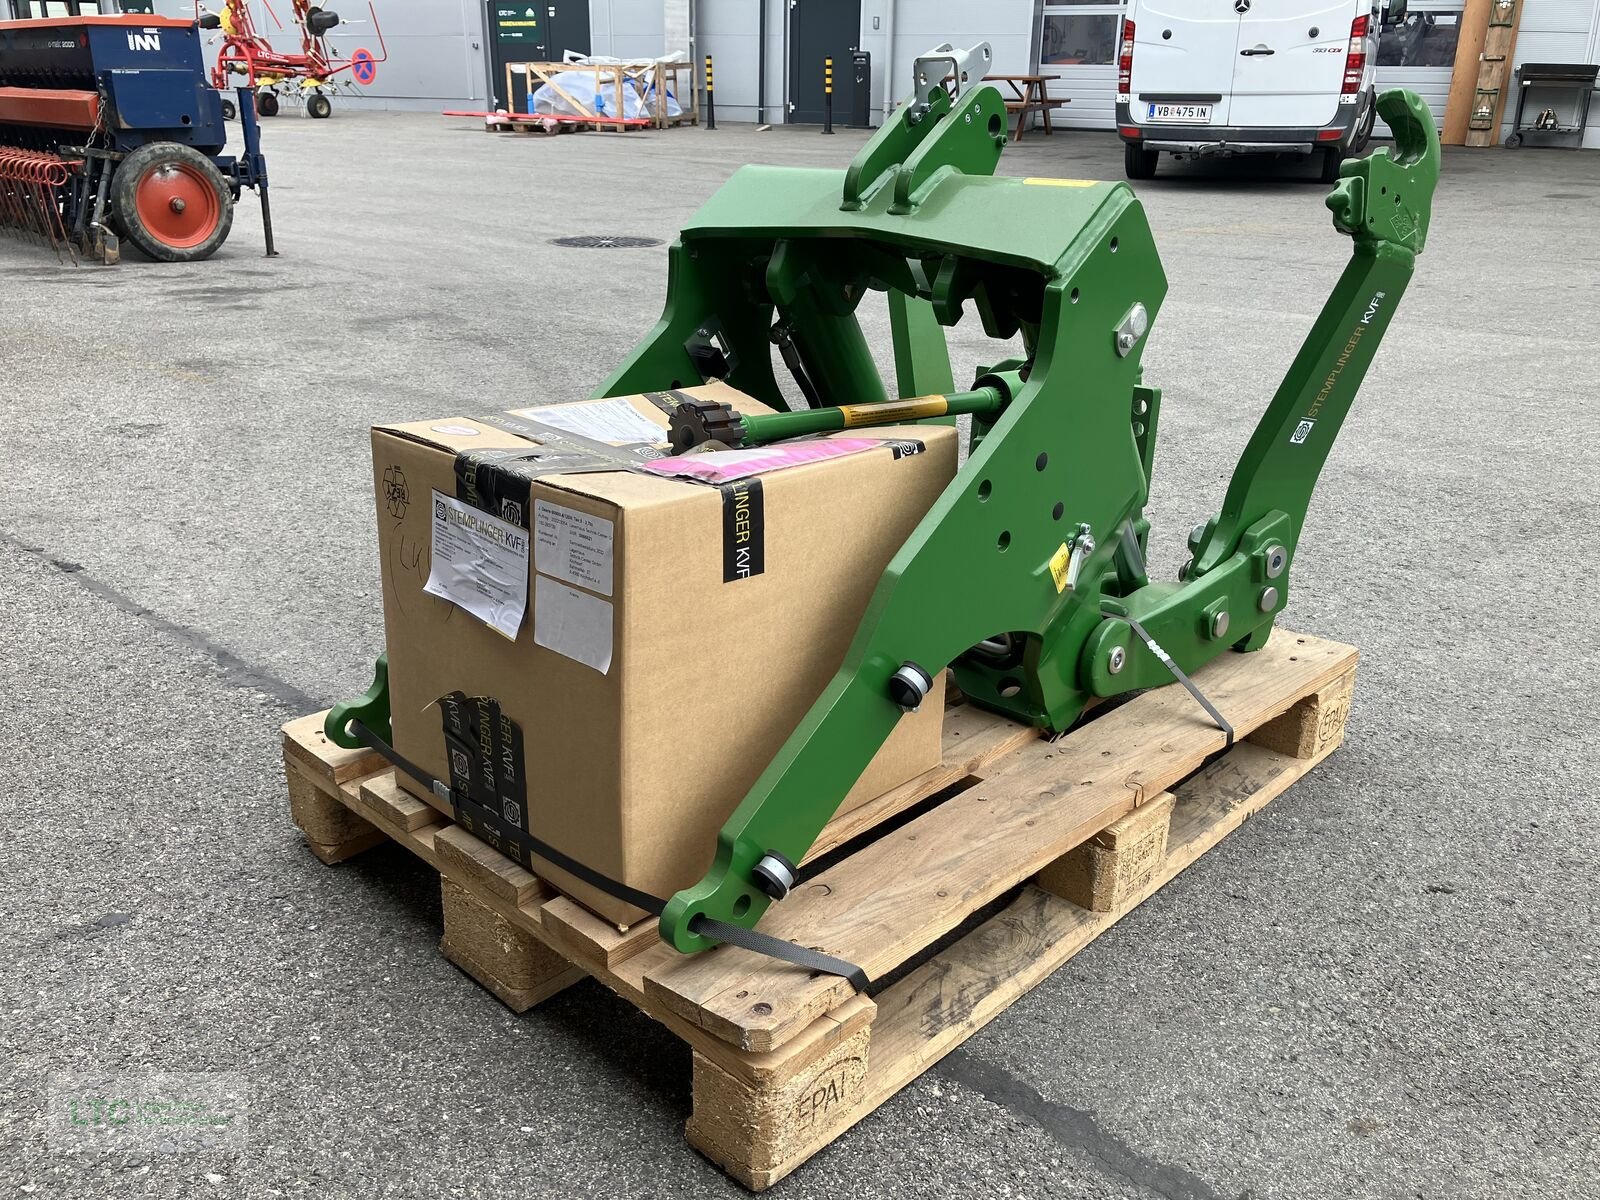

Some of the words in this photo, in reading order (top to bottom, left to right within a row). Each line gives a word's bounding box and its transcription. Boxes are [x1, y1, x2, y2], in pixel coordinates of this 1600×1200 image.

[1158, 106, 1169, 116] VB
[1176, 107, 1195, 117] 475
[1196, 107, 1207, 117] IN
[1308, 325, 1366, 418] STEMPLINGER
[1360, 297, 1381, 325] KVF
[448, 506, 504, 544] STEMPLINGER
[505, 531, 522, 551] KVF
[736, 546, 751, 579] KVF
[482, 756, 496, 789] KVF
[503, 744, 516, 778] KVF
